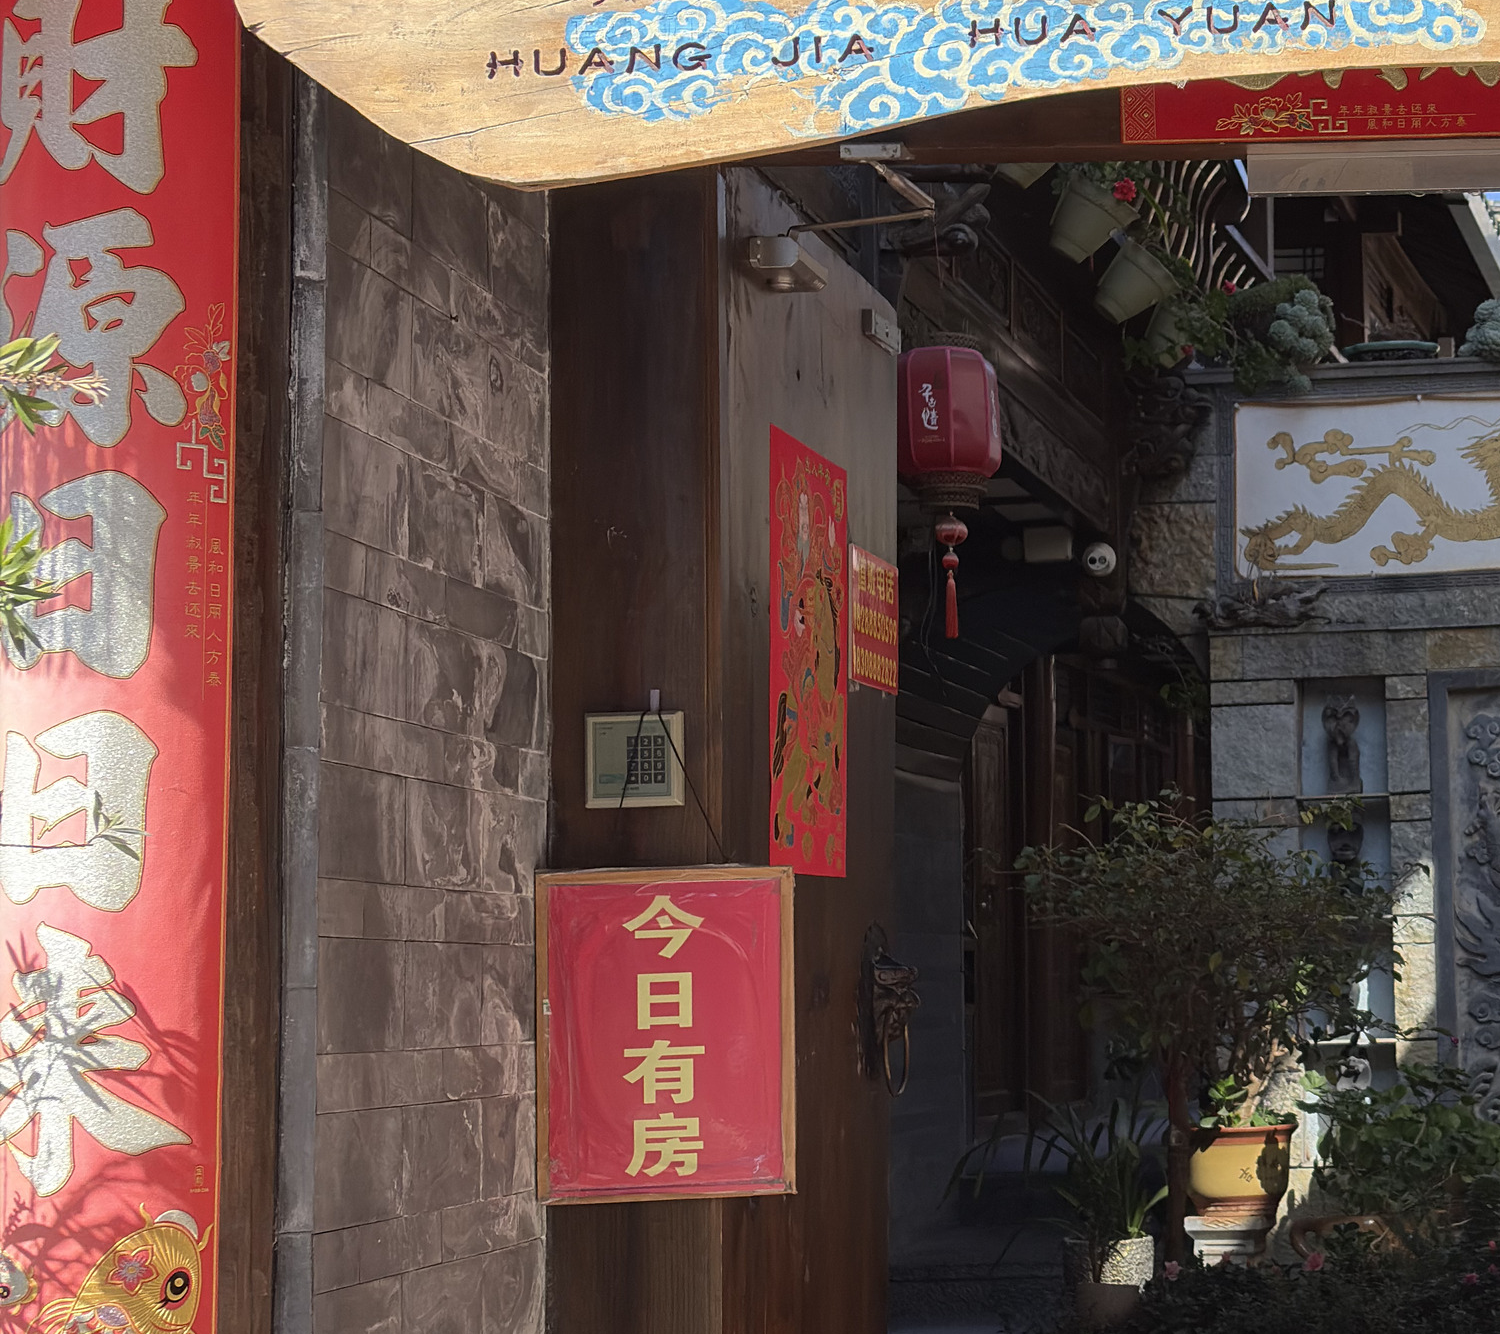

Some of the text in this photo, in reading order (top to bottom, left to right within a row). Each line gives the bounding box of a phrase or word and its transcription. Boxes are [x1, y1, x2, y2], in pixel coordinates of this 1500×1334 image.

[487, 41, 712, 79] HUANG
[771, 33, 875, 67] JIA
[968, 13, 1097, 48] HUA
[622, 894, 705, 1178] 今日有房
